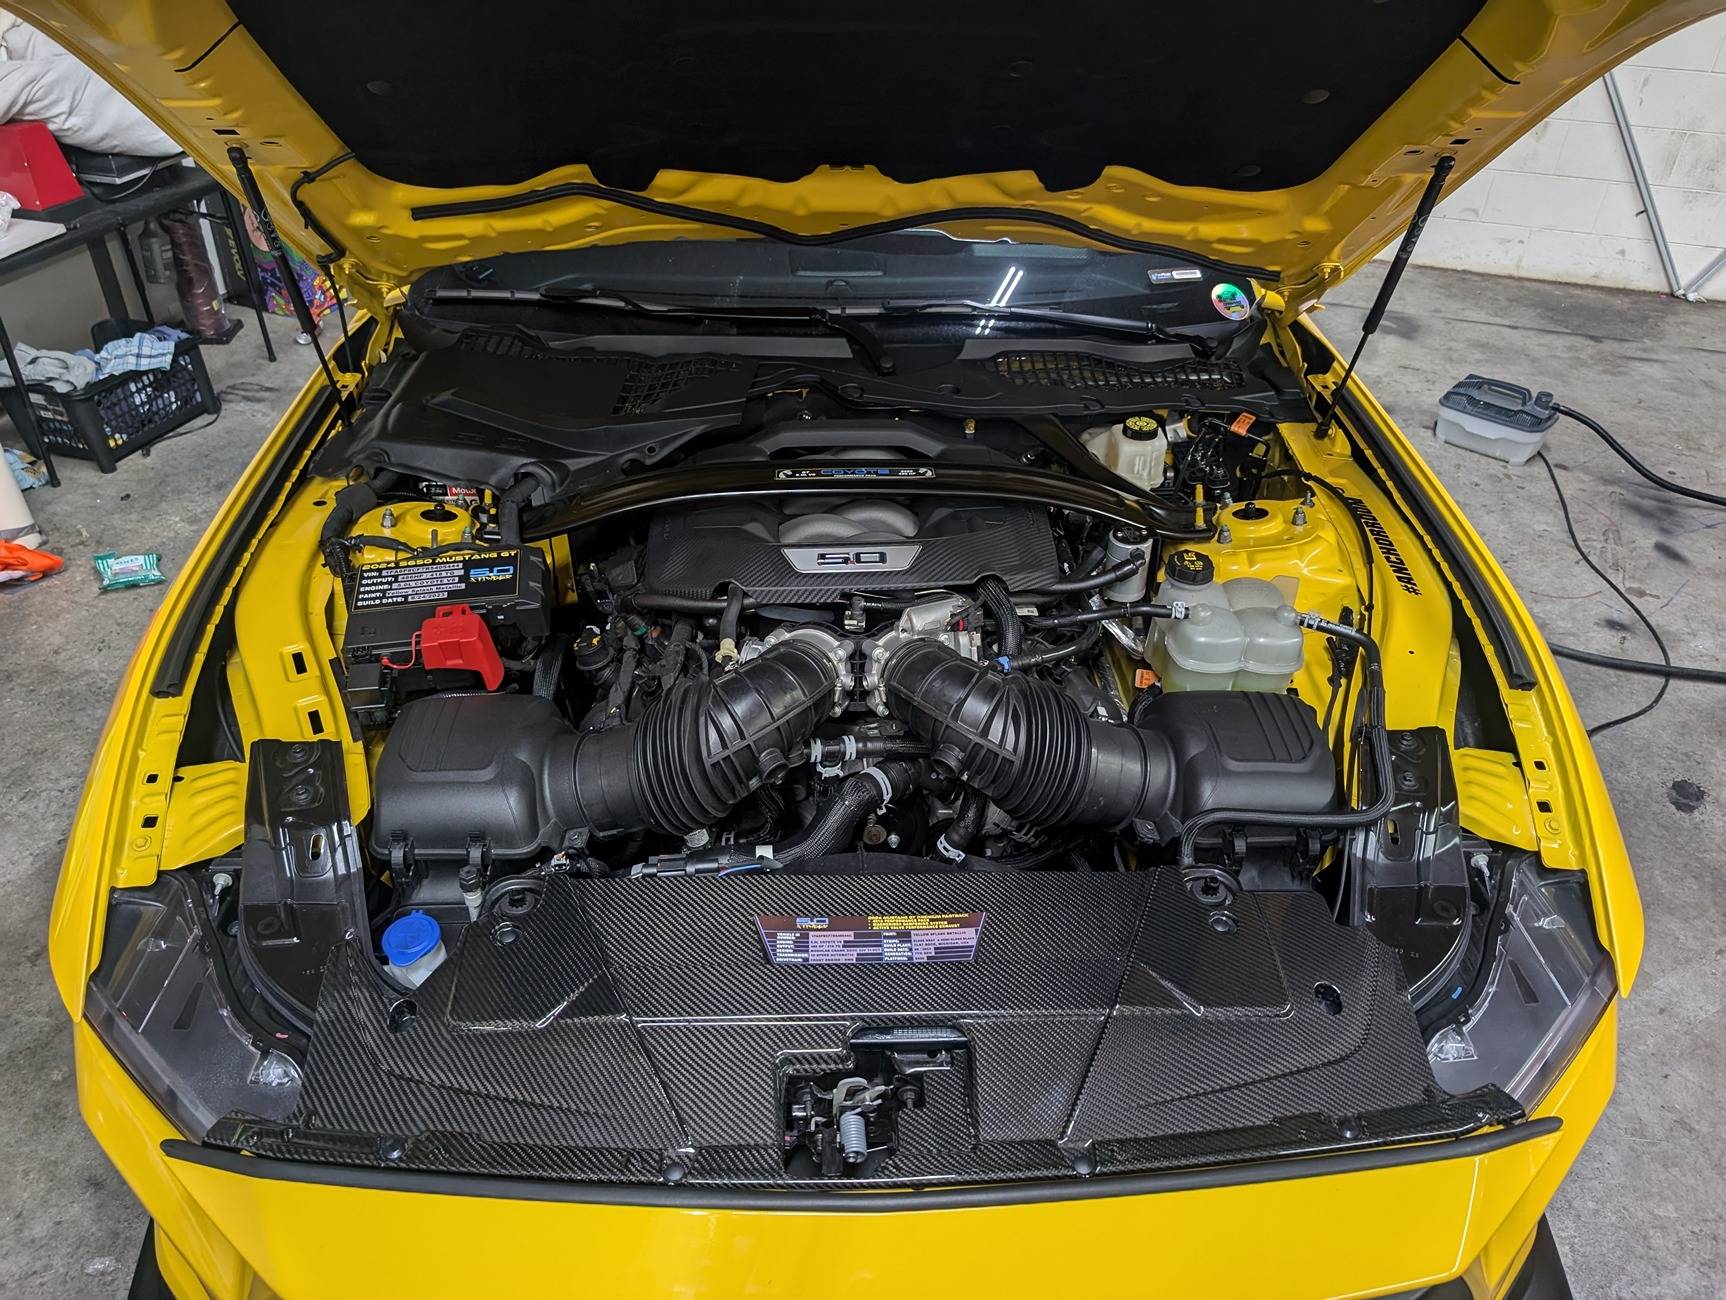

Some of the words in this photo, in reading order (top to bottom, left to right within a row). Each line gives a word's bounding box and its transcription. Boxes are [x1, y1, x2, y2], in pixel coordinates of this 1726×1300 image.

[362, 562, 395, 570] 2024
[399, 558, 432, 566] S650
[435, 552, 497, 562] MUSTANG
[816, 552, 887, 566] 5.0
[470, 566, 514, 577] 5.0
